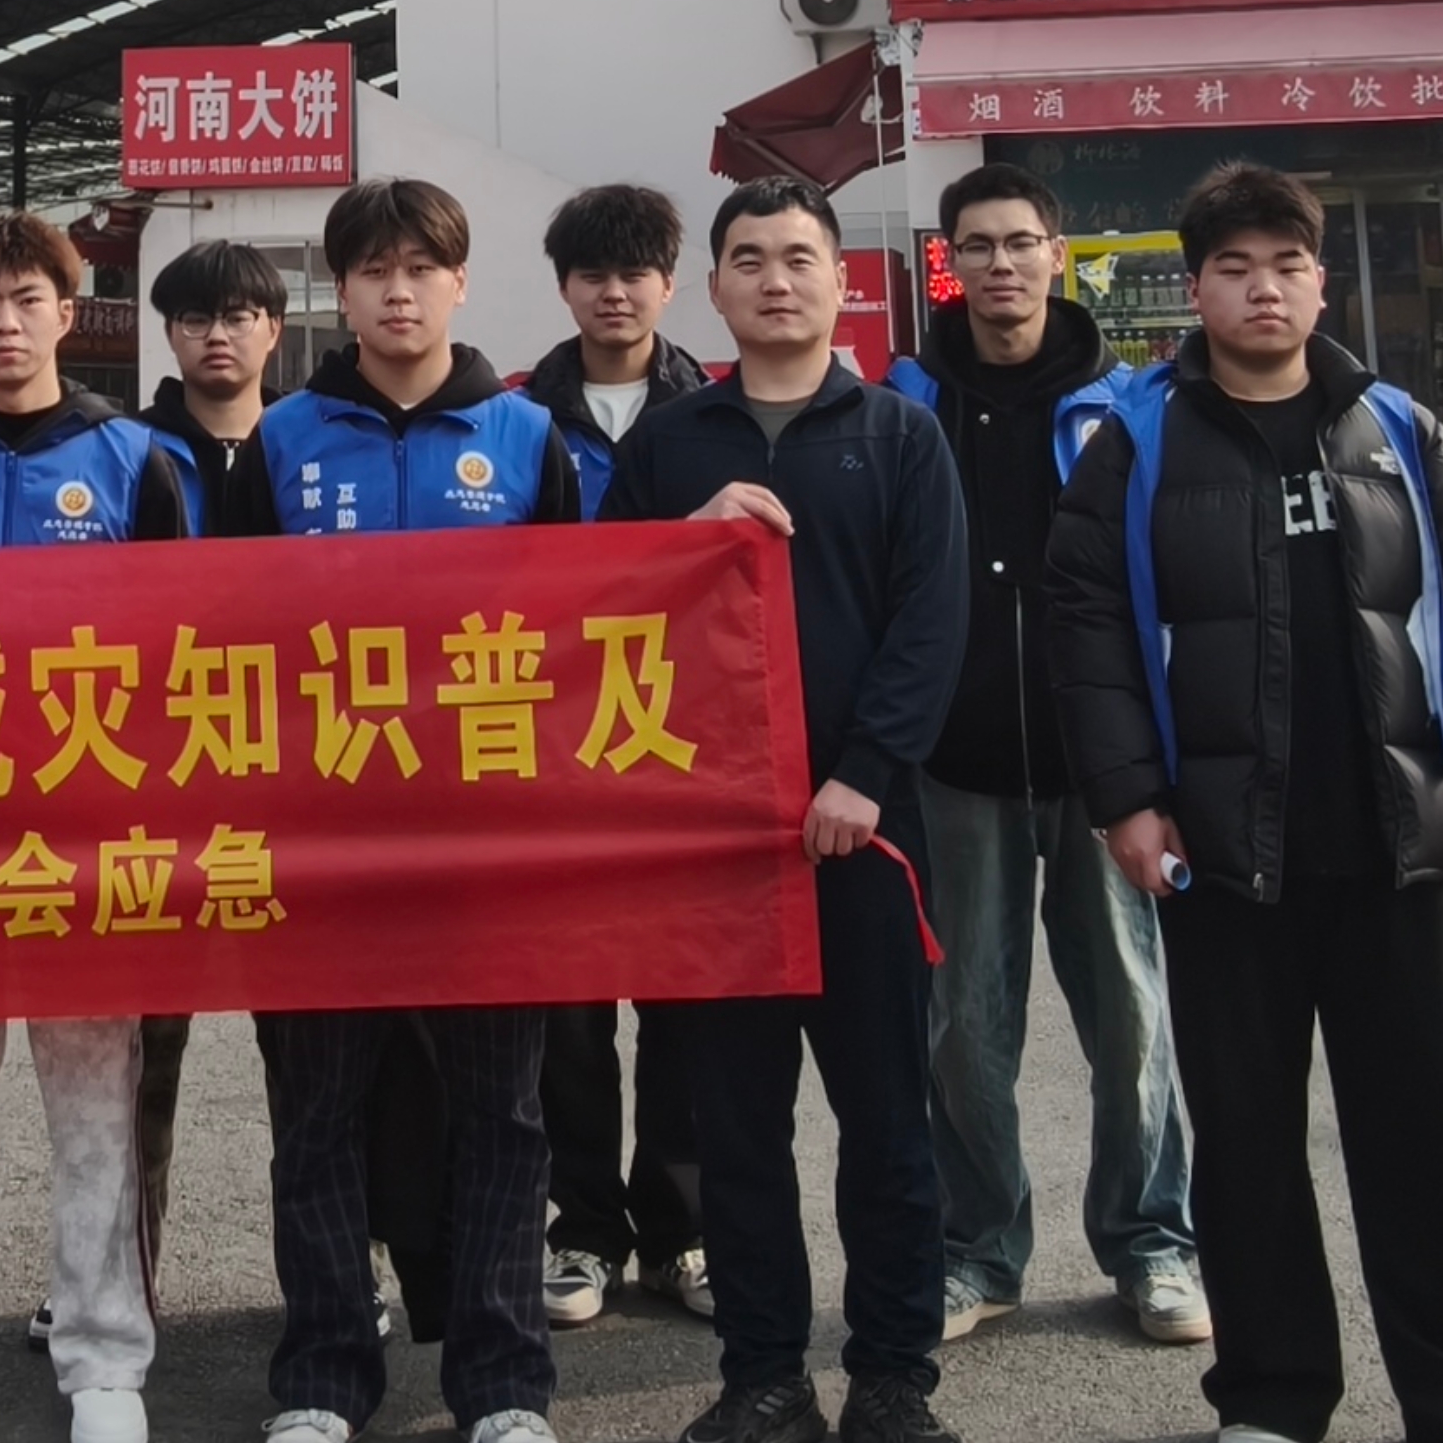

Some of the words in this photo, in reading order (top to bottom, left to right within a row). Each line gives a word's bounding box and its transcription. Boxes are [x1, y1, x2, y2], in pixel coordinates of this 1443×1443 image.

[134, 67, 338, 143] 河南大饼
[968, 88, 1065, 122] 烟酒
[1130, 80, 1230, 116] 饮料
